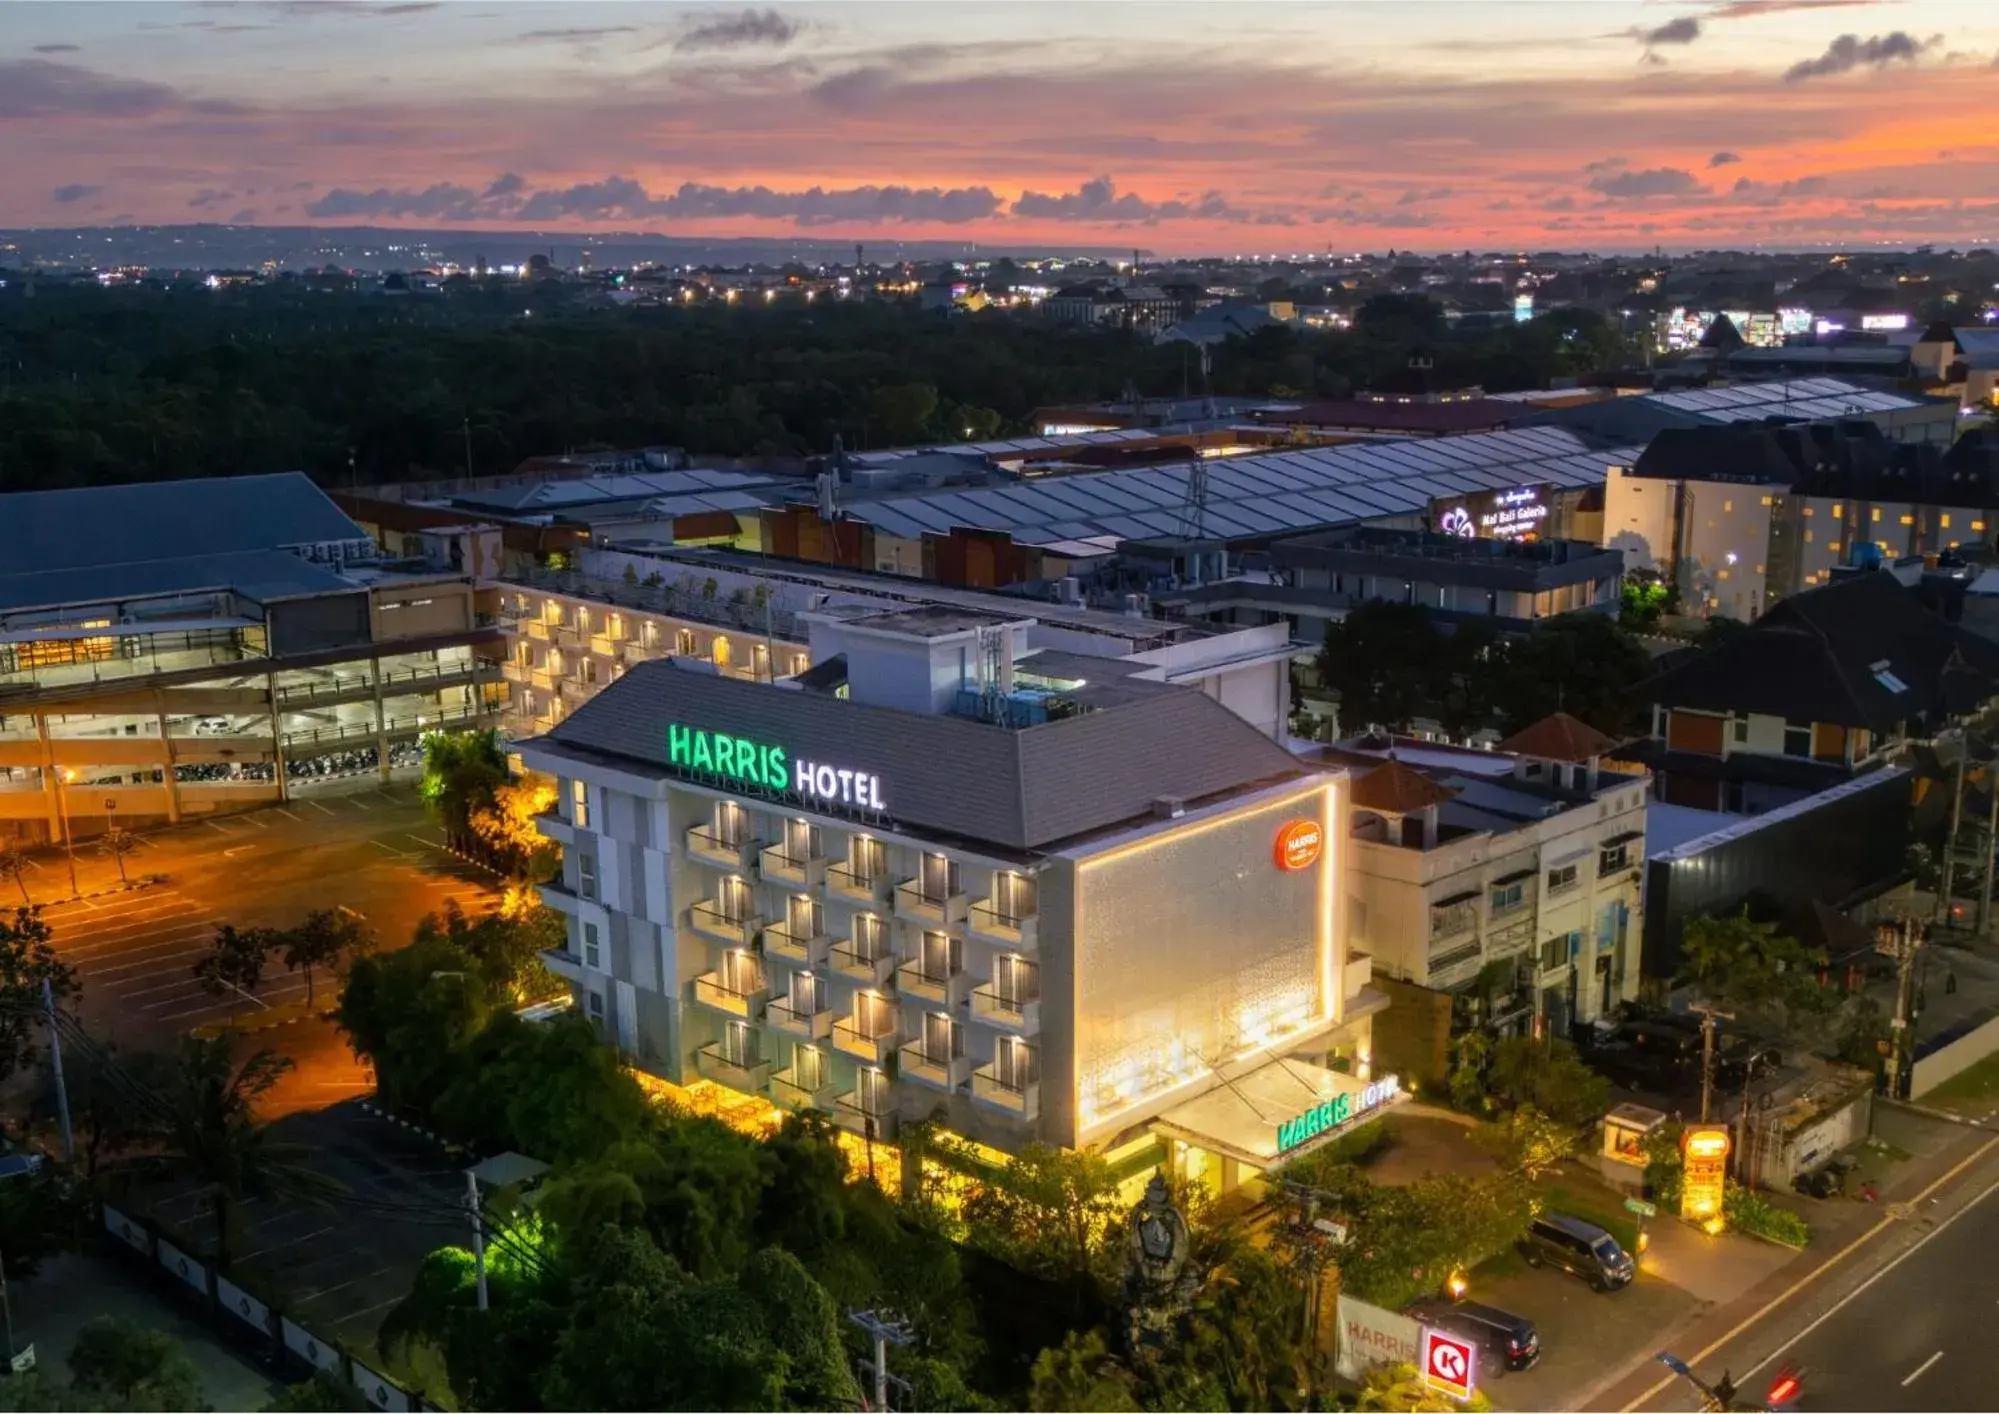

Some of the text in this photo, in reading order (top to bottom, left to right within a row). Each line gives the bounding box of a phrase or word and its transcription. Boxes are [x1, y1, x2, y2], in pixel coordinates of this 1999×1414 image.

[669, 723, 886, 810] HARRIS HOTEL
[1277, 1092, 1350, 1153] HARRIS
[1348, 1321, 1417, 1361] HARRIS
